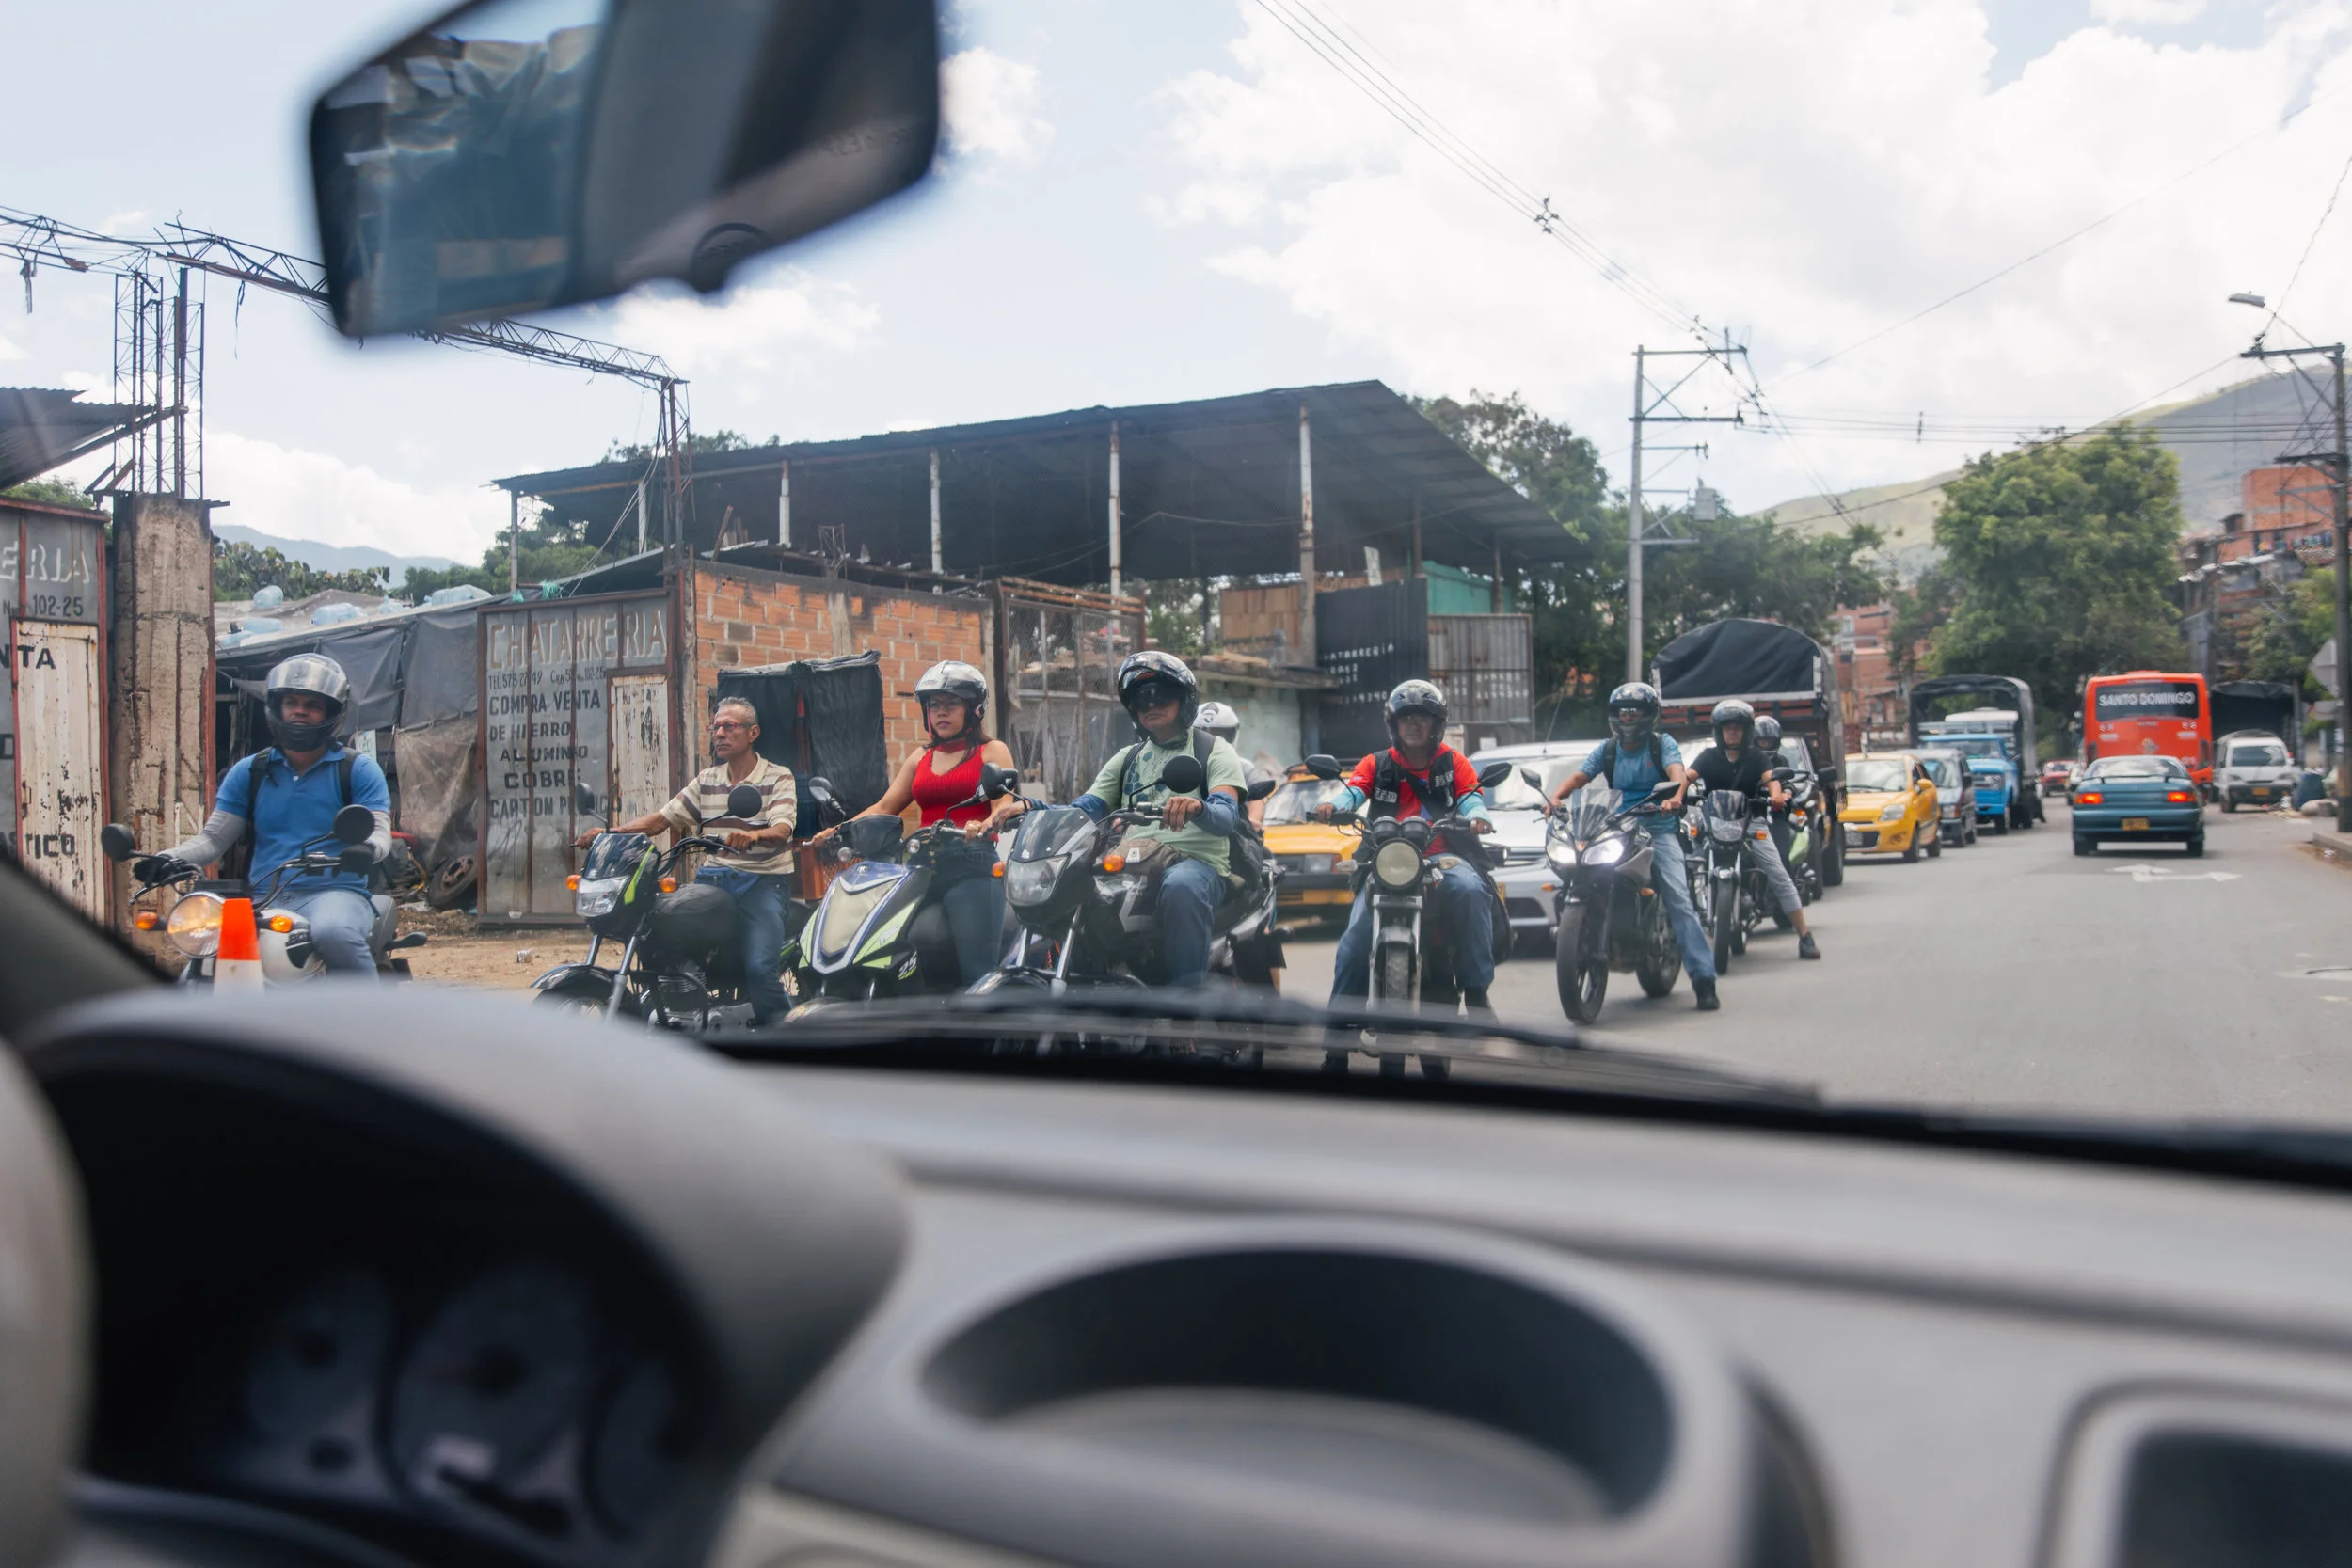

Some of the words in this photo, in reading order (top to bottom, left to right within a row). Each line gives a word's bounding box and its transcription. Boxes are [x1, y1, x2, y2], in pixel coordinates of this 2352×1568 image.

[32, 594, 85, 618] 102-25
[489, 610, 669, 671] CHATARRERIA
[489, 695, 547, 716] COMPRA
[553, 689, 601, 711] VENTA
[2098, 693, 2138, 707] SANTO
[2139, 691, 2196, 705] DOMINGO
[489, 725, 506, 742] DE
[511, 721, 571, 740] HIERRO
[490, 796, 553, 820] CARTON
